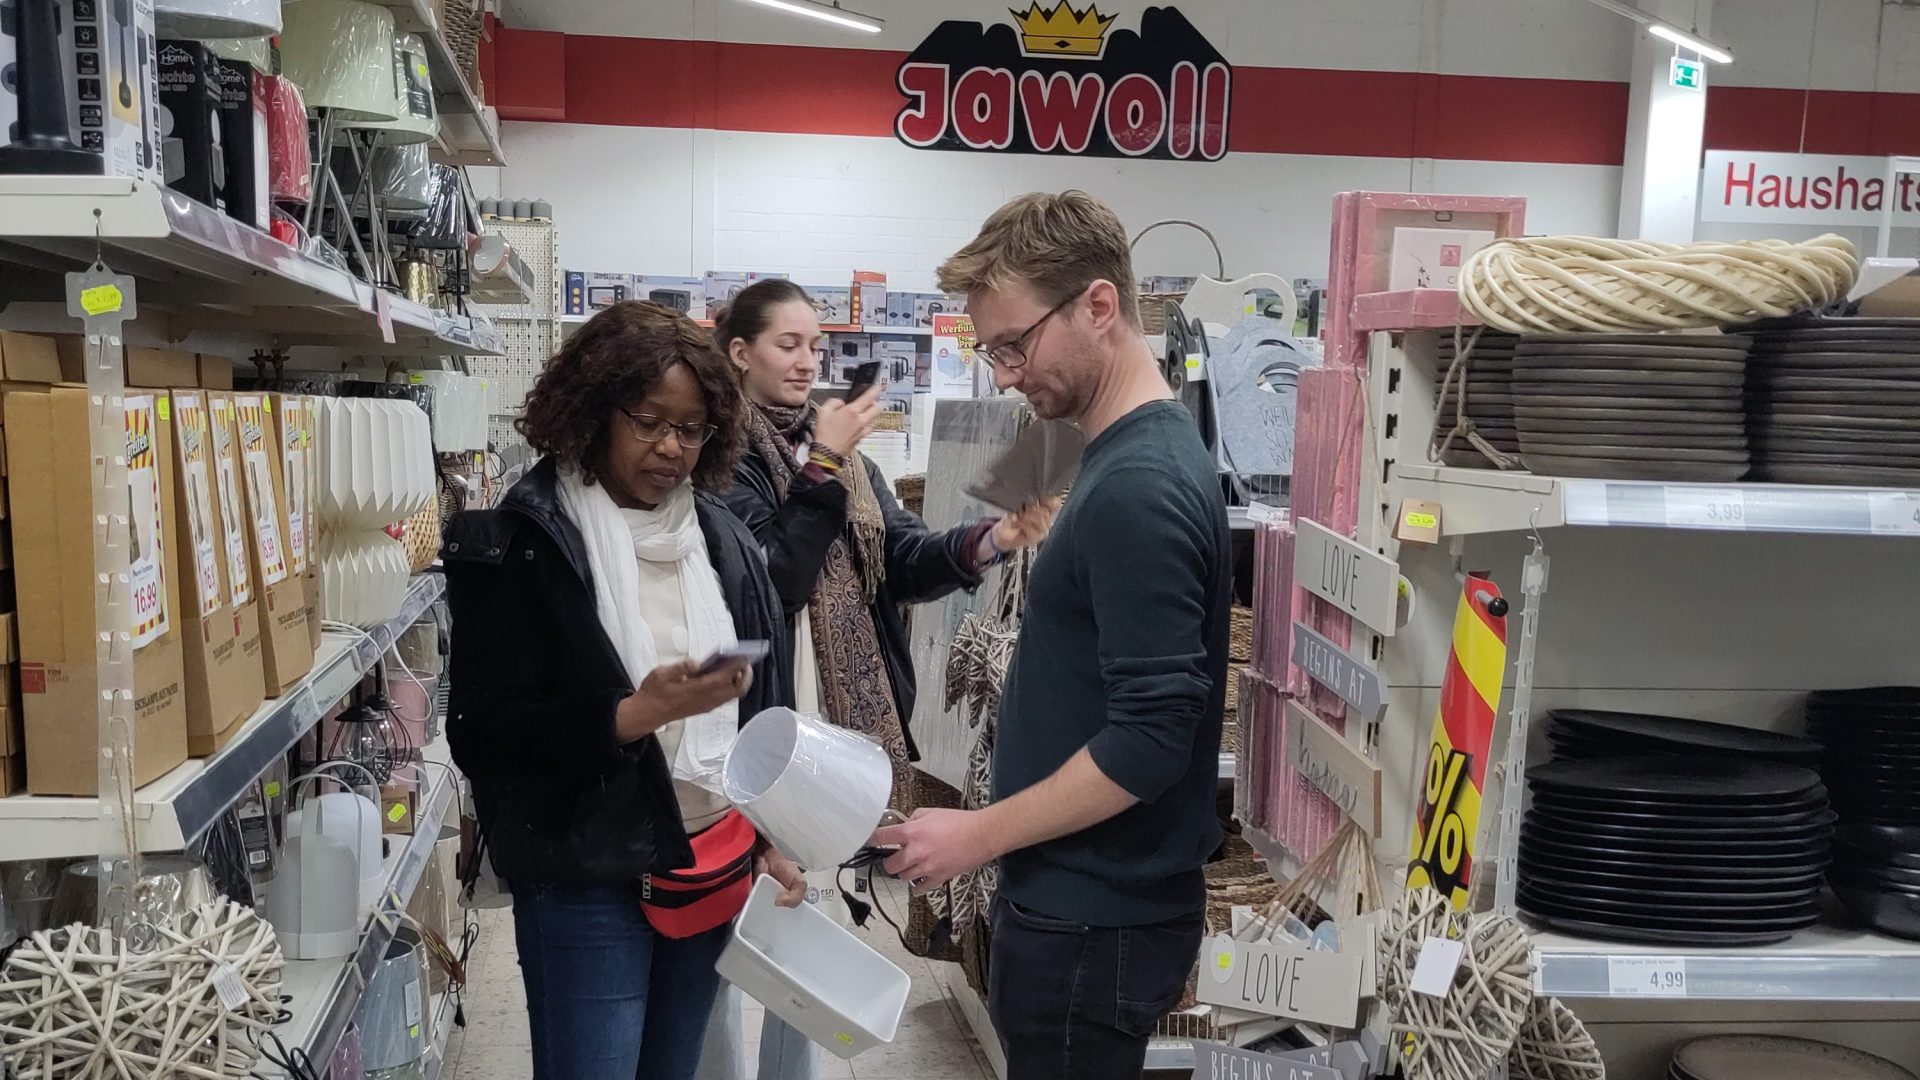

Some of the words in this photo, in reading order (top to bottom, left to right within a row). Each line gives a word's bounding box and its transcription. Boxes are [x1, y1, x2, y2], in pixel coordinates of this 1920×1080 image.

[897, 60, 1230, 160] Jawoll
[1724, 161, 1920, 212] Haushat
[940, 324, 976, 334] Werbun
[1707, 502, 1743, 521] 3,99
[134, 581, 157, 615] 16,99
[1321, 539, 1361, 611] LOVE
[1303, 636, 1343, 690] BEGINS
[1348, 670, 1367, 707] AT
[1241, 950, 1305, 1012] LOVE
[1650, 971, 1684, 991] 4,99
